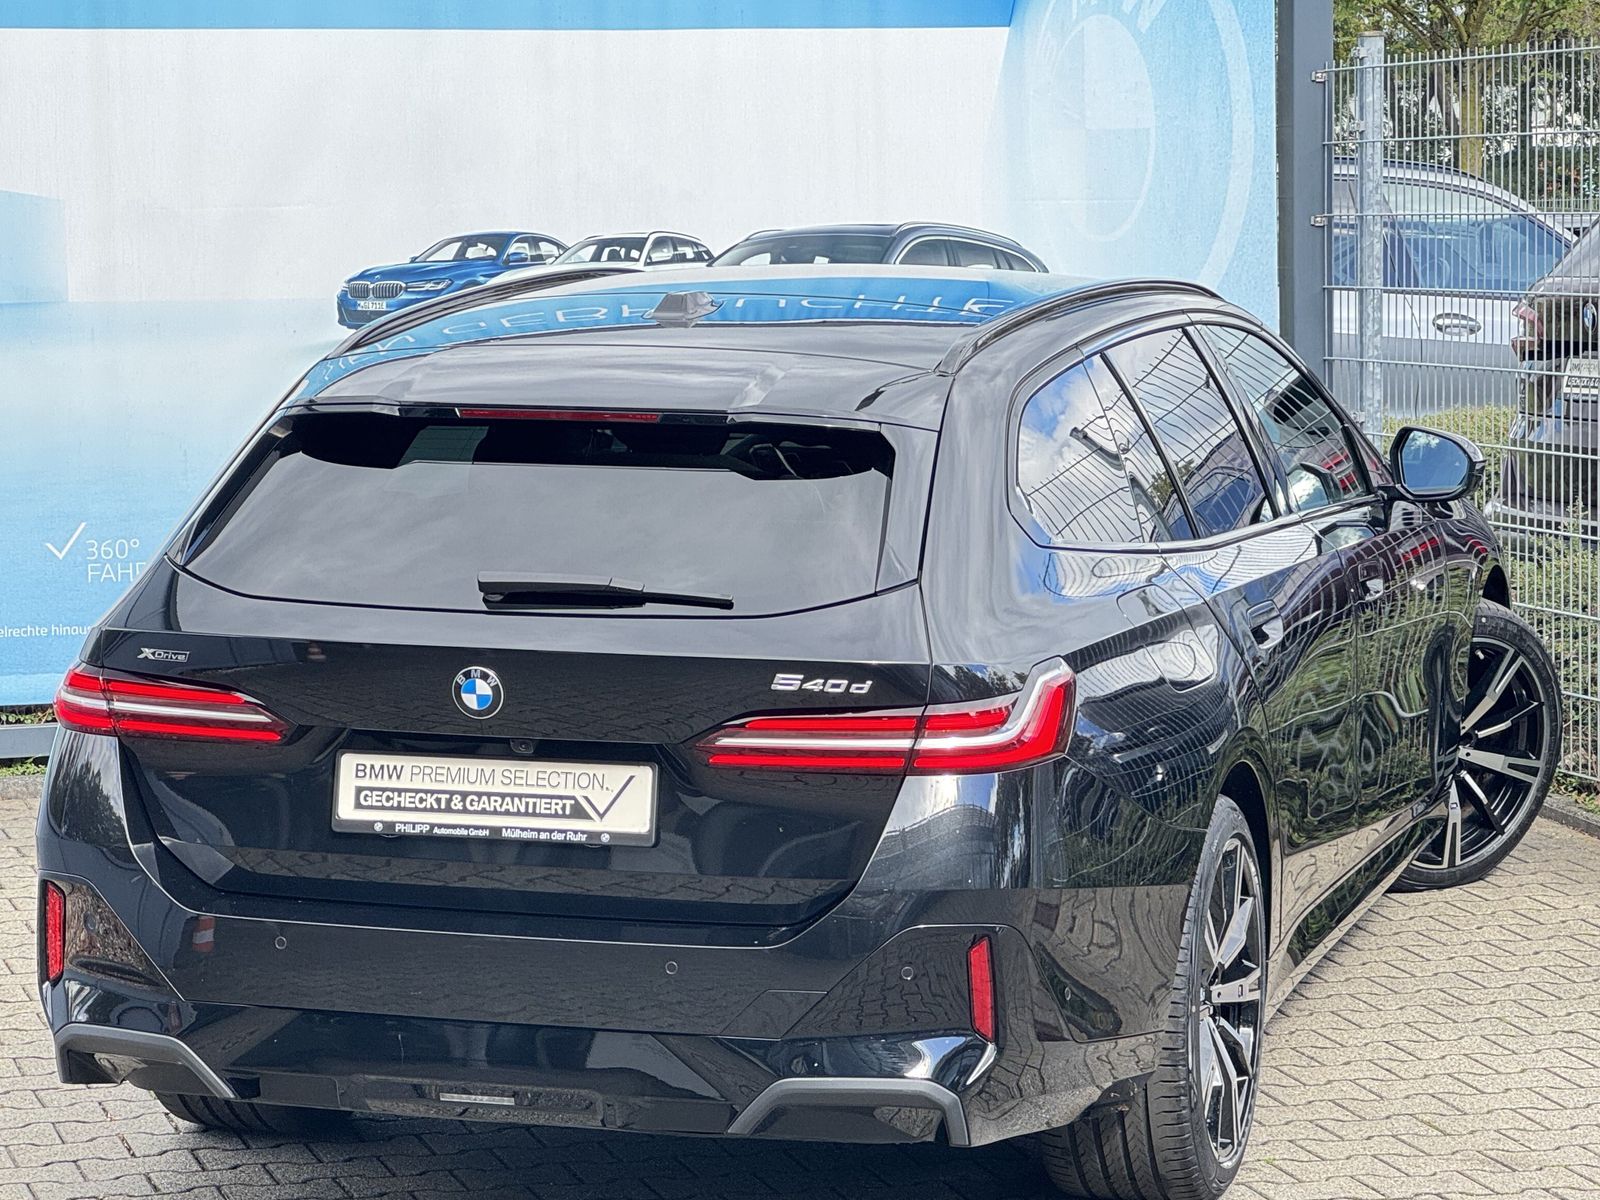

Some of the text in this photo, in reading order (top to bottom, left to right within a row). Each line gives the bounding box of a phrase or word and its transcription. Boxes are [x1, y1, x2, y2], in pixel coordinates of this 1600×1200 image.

[85, 538, 140, 560] 360°
[457, 669, 498, 687] BMW
[770, 673, 873, 694] 540d
[355, 763, 404, 780] BMW
[410, 765, 495, 785] PREMIUM
[360, 790, 575, 815] GECHECKT & GARANTIERT
[395, 823, 588, 842] PHILIPP Automobile GmbH Mülheim an der Ruhr
